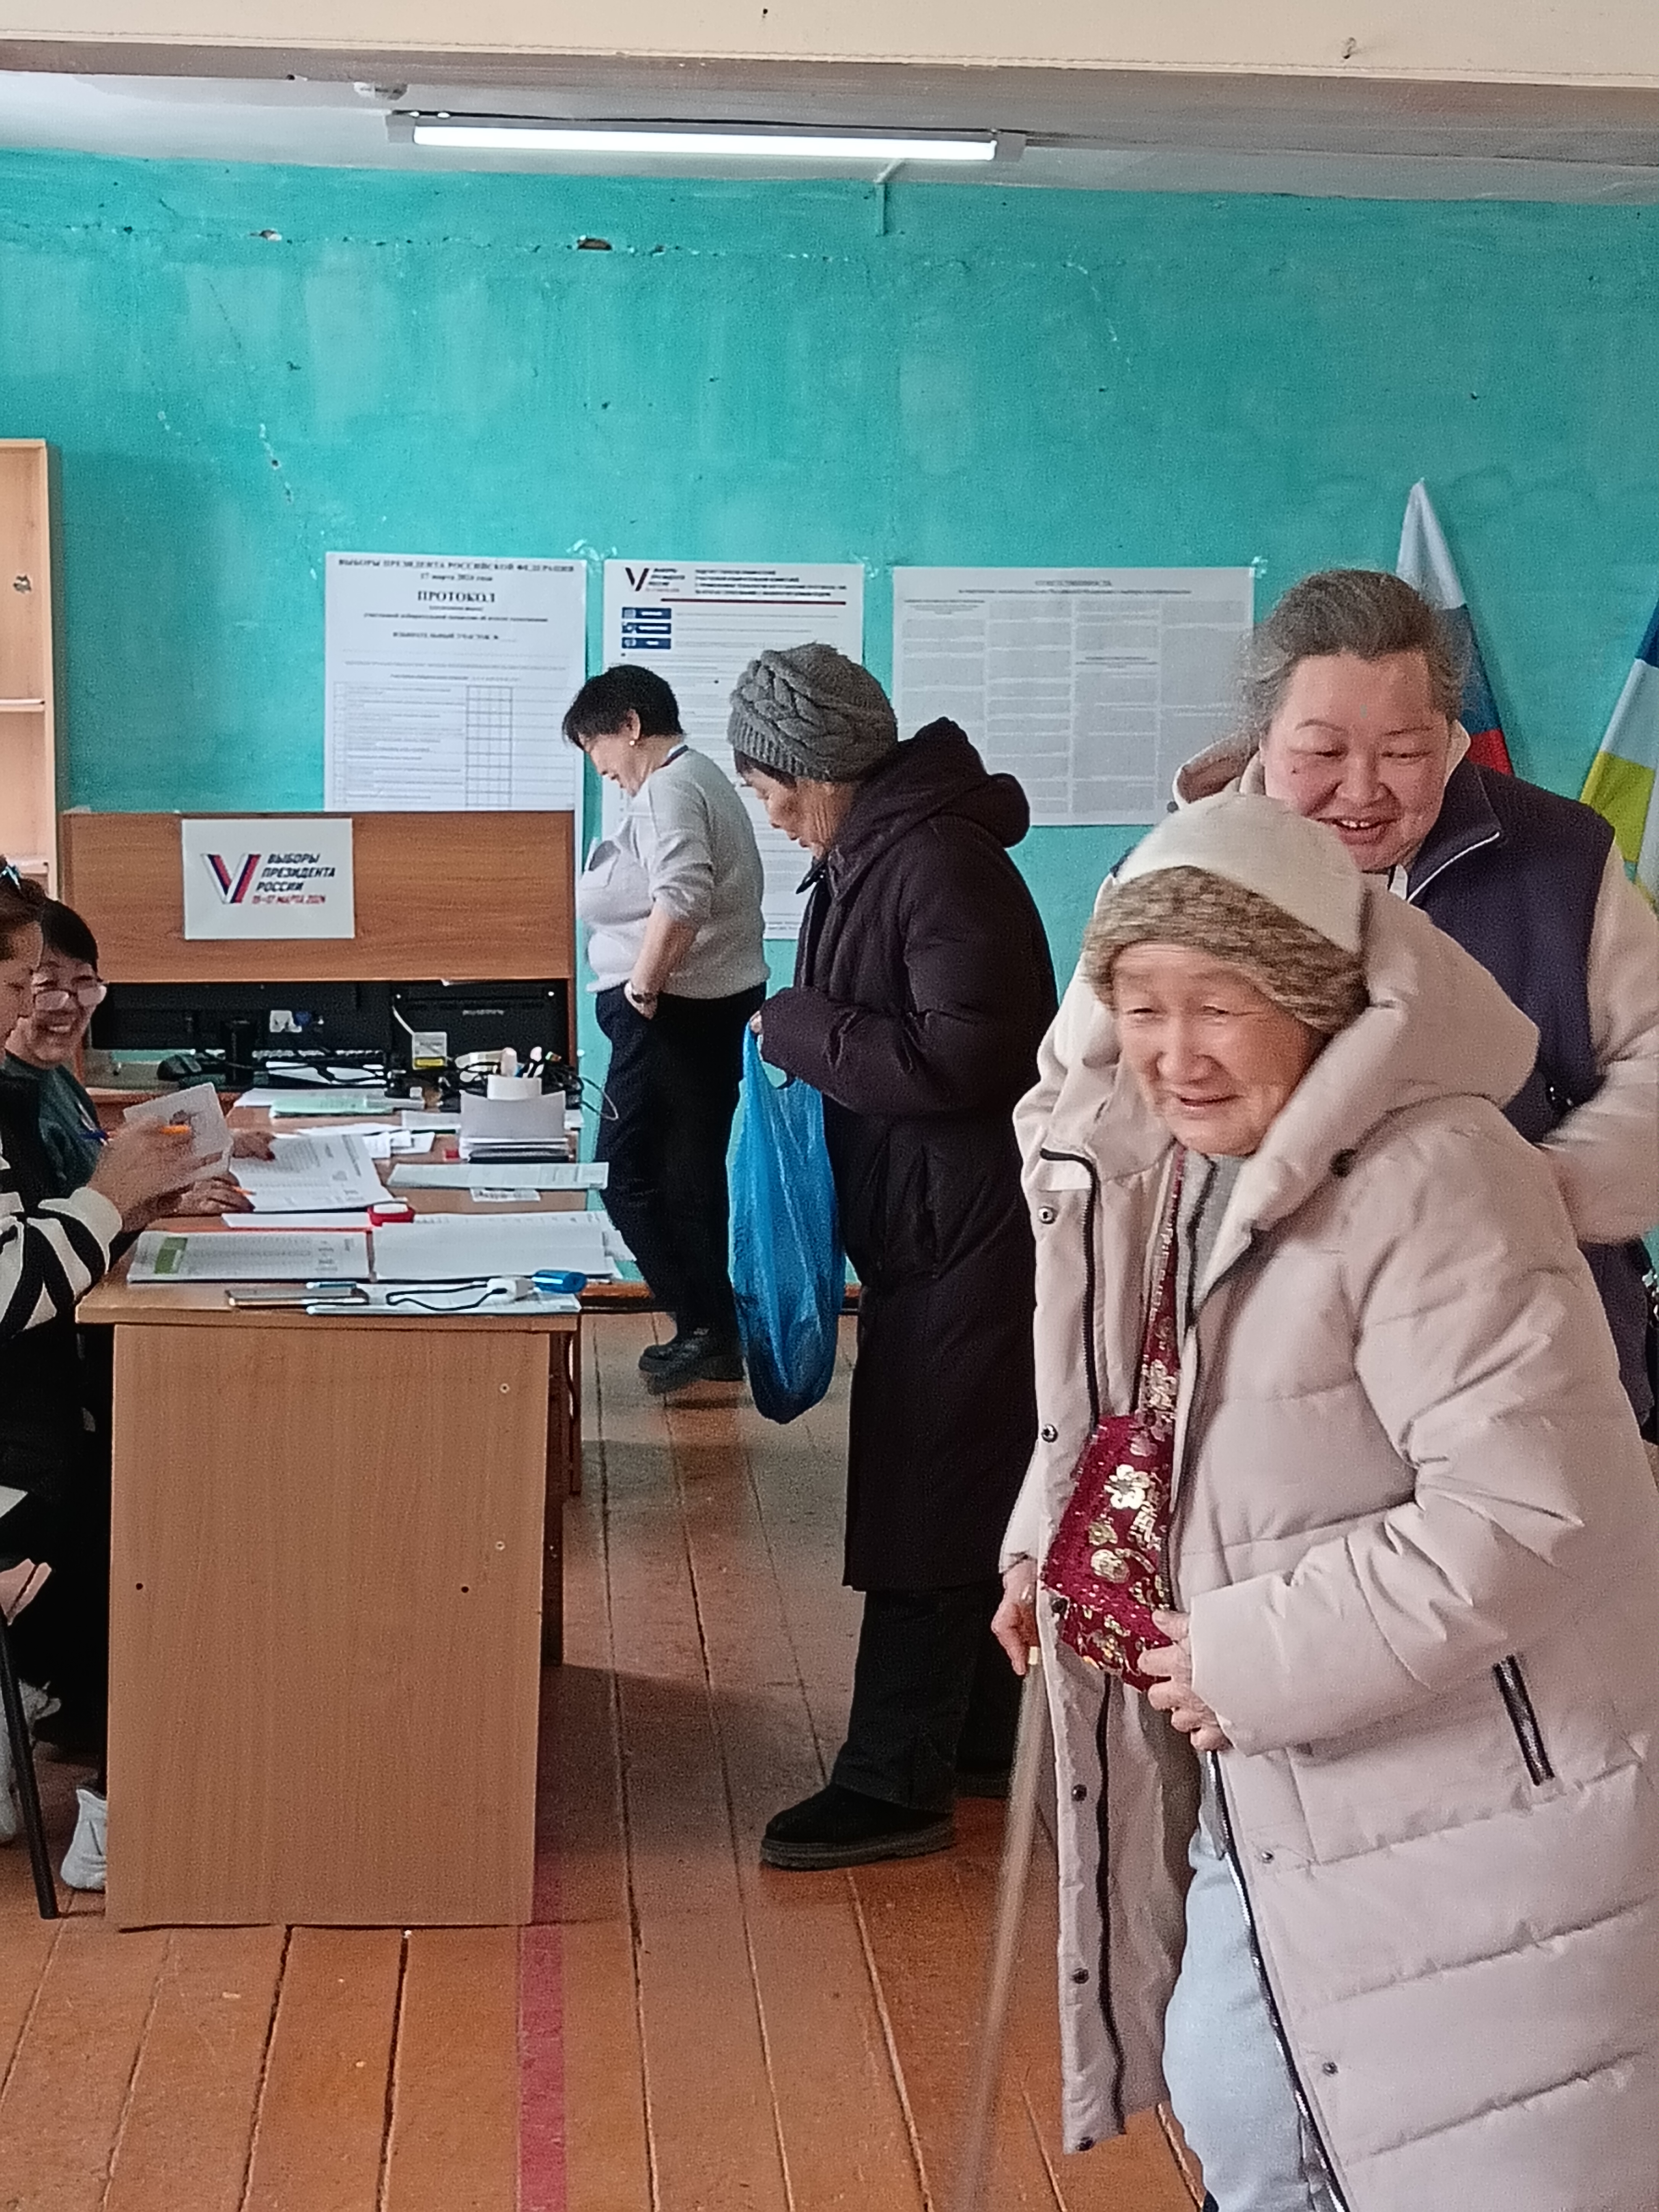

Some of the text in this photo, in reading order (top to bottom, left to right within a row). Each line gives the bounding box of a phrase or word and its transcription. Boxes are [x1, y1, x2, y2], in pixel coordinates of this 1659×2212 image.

[418, 591, 495, 603] ПРОТОКОЛ
[267, 854, 320, 864] ВЫБОРЫ
[261, 867, 336, 878] ПРЕЗИДЕНТА
[255, 881, 304, 892] РОССИИ
[277, 895, 304, 904] МАРТА
[306, 895, 326, 904] 2024
